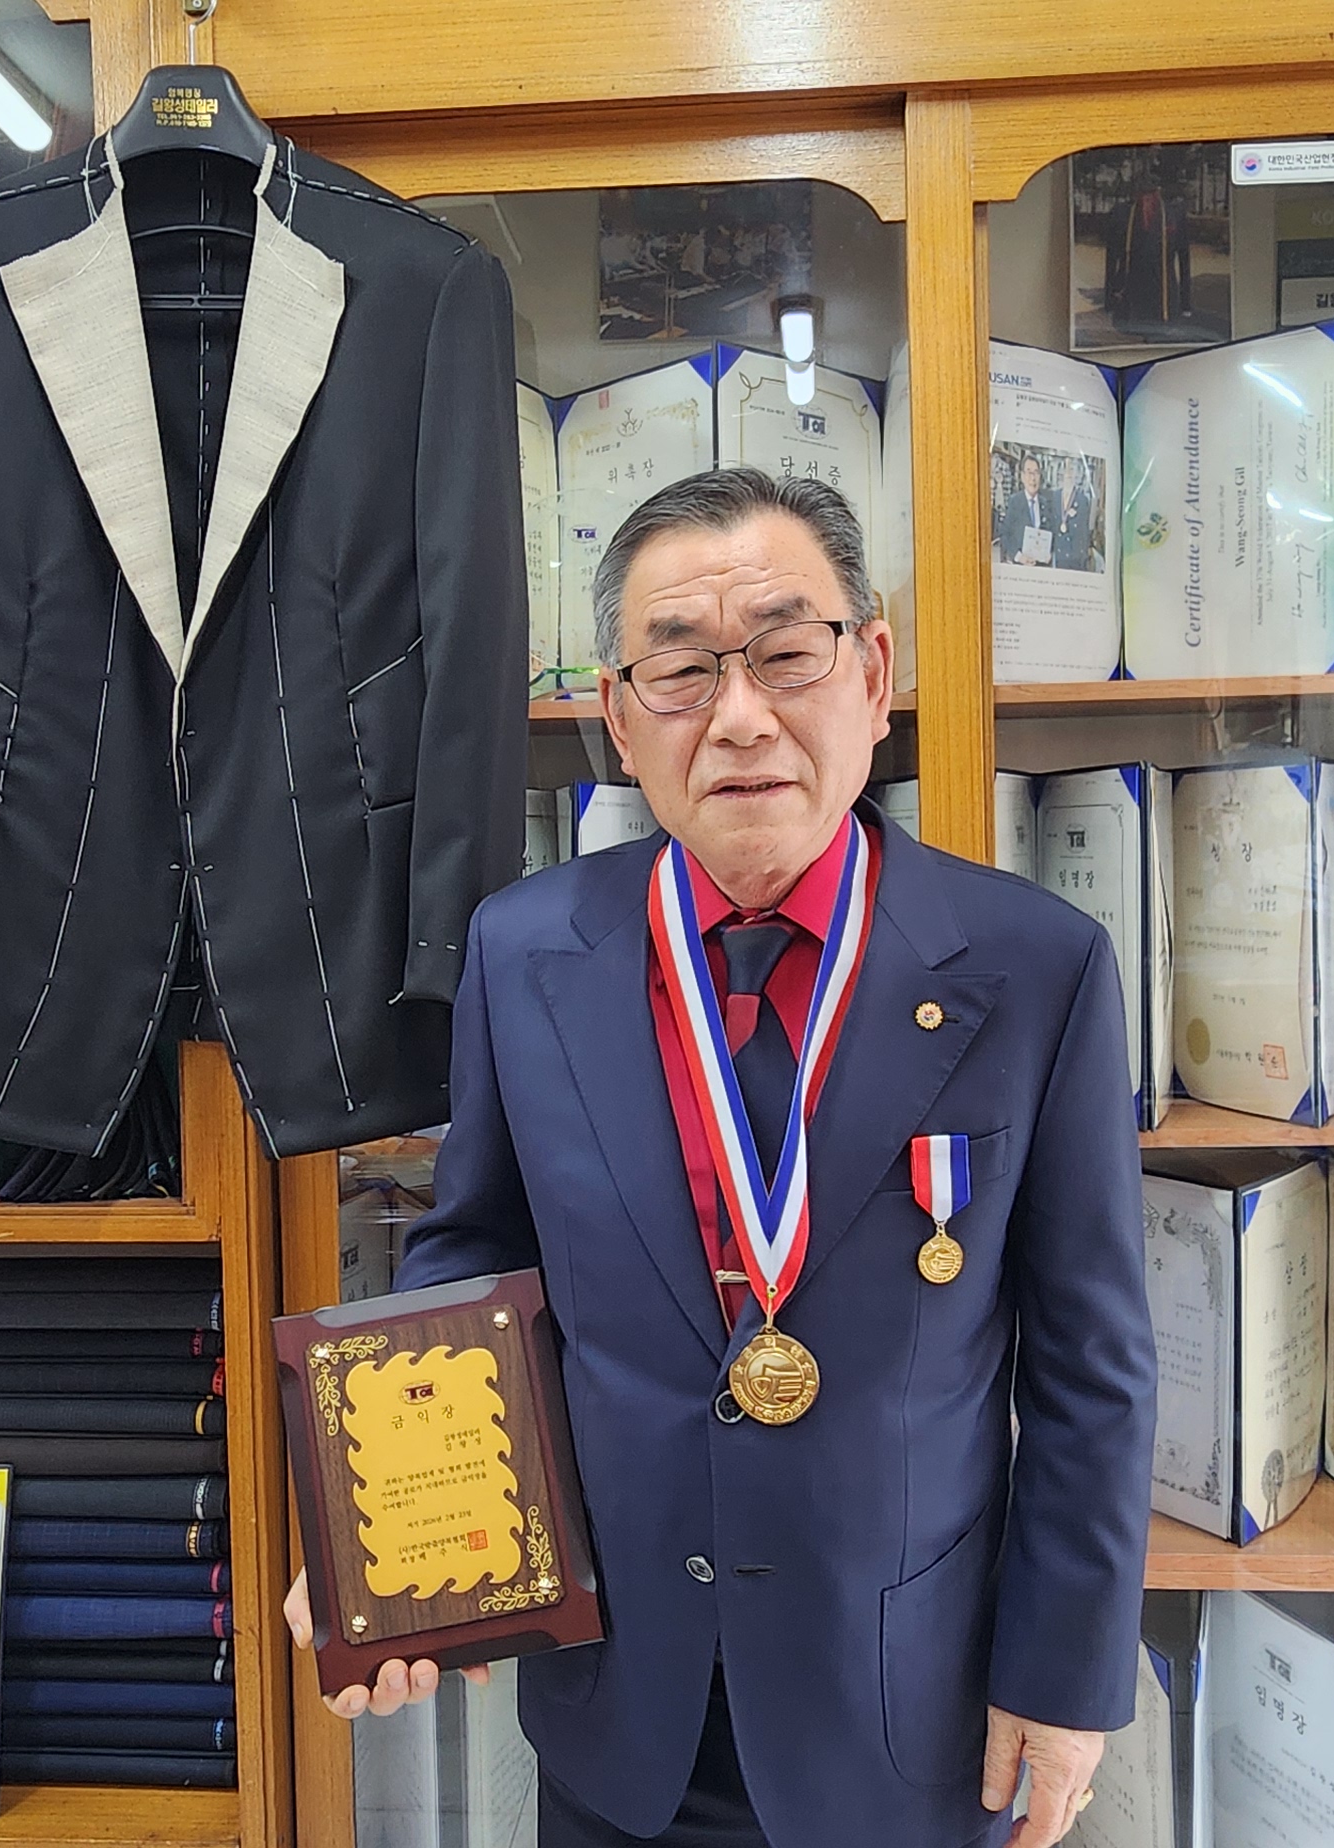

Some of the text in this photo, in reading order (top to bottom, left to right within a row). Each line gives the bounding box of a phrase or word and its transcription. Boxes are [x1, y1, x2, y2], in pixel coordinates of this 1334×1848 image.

[152, 98, 219, 114] 길왕성테일러
[989, 372, 1019, 386] USAN
[1182, 397, 1205, 648] Certificate of Attendance
[1233, 466, 1247, 567] Wang-Seong Gil
